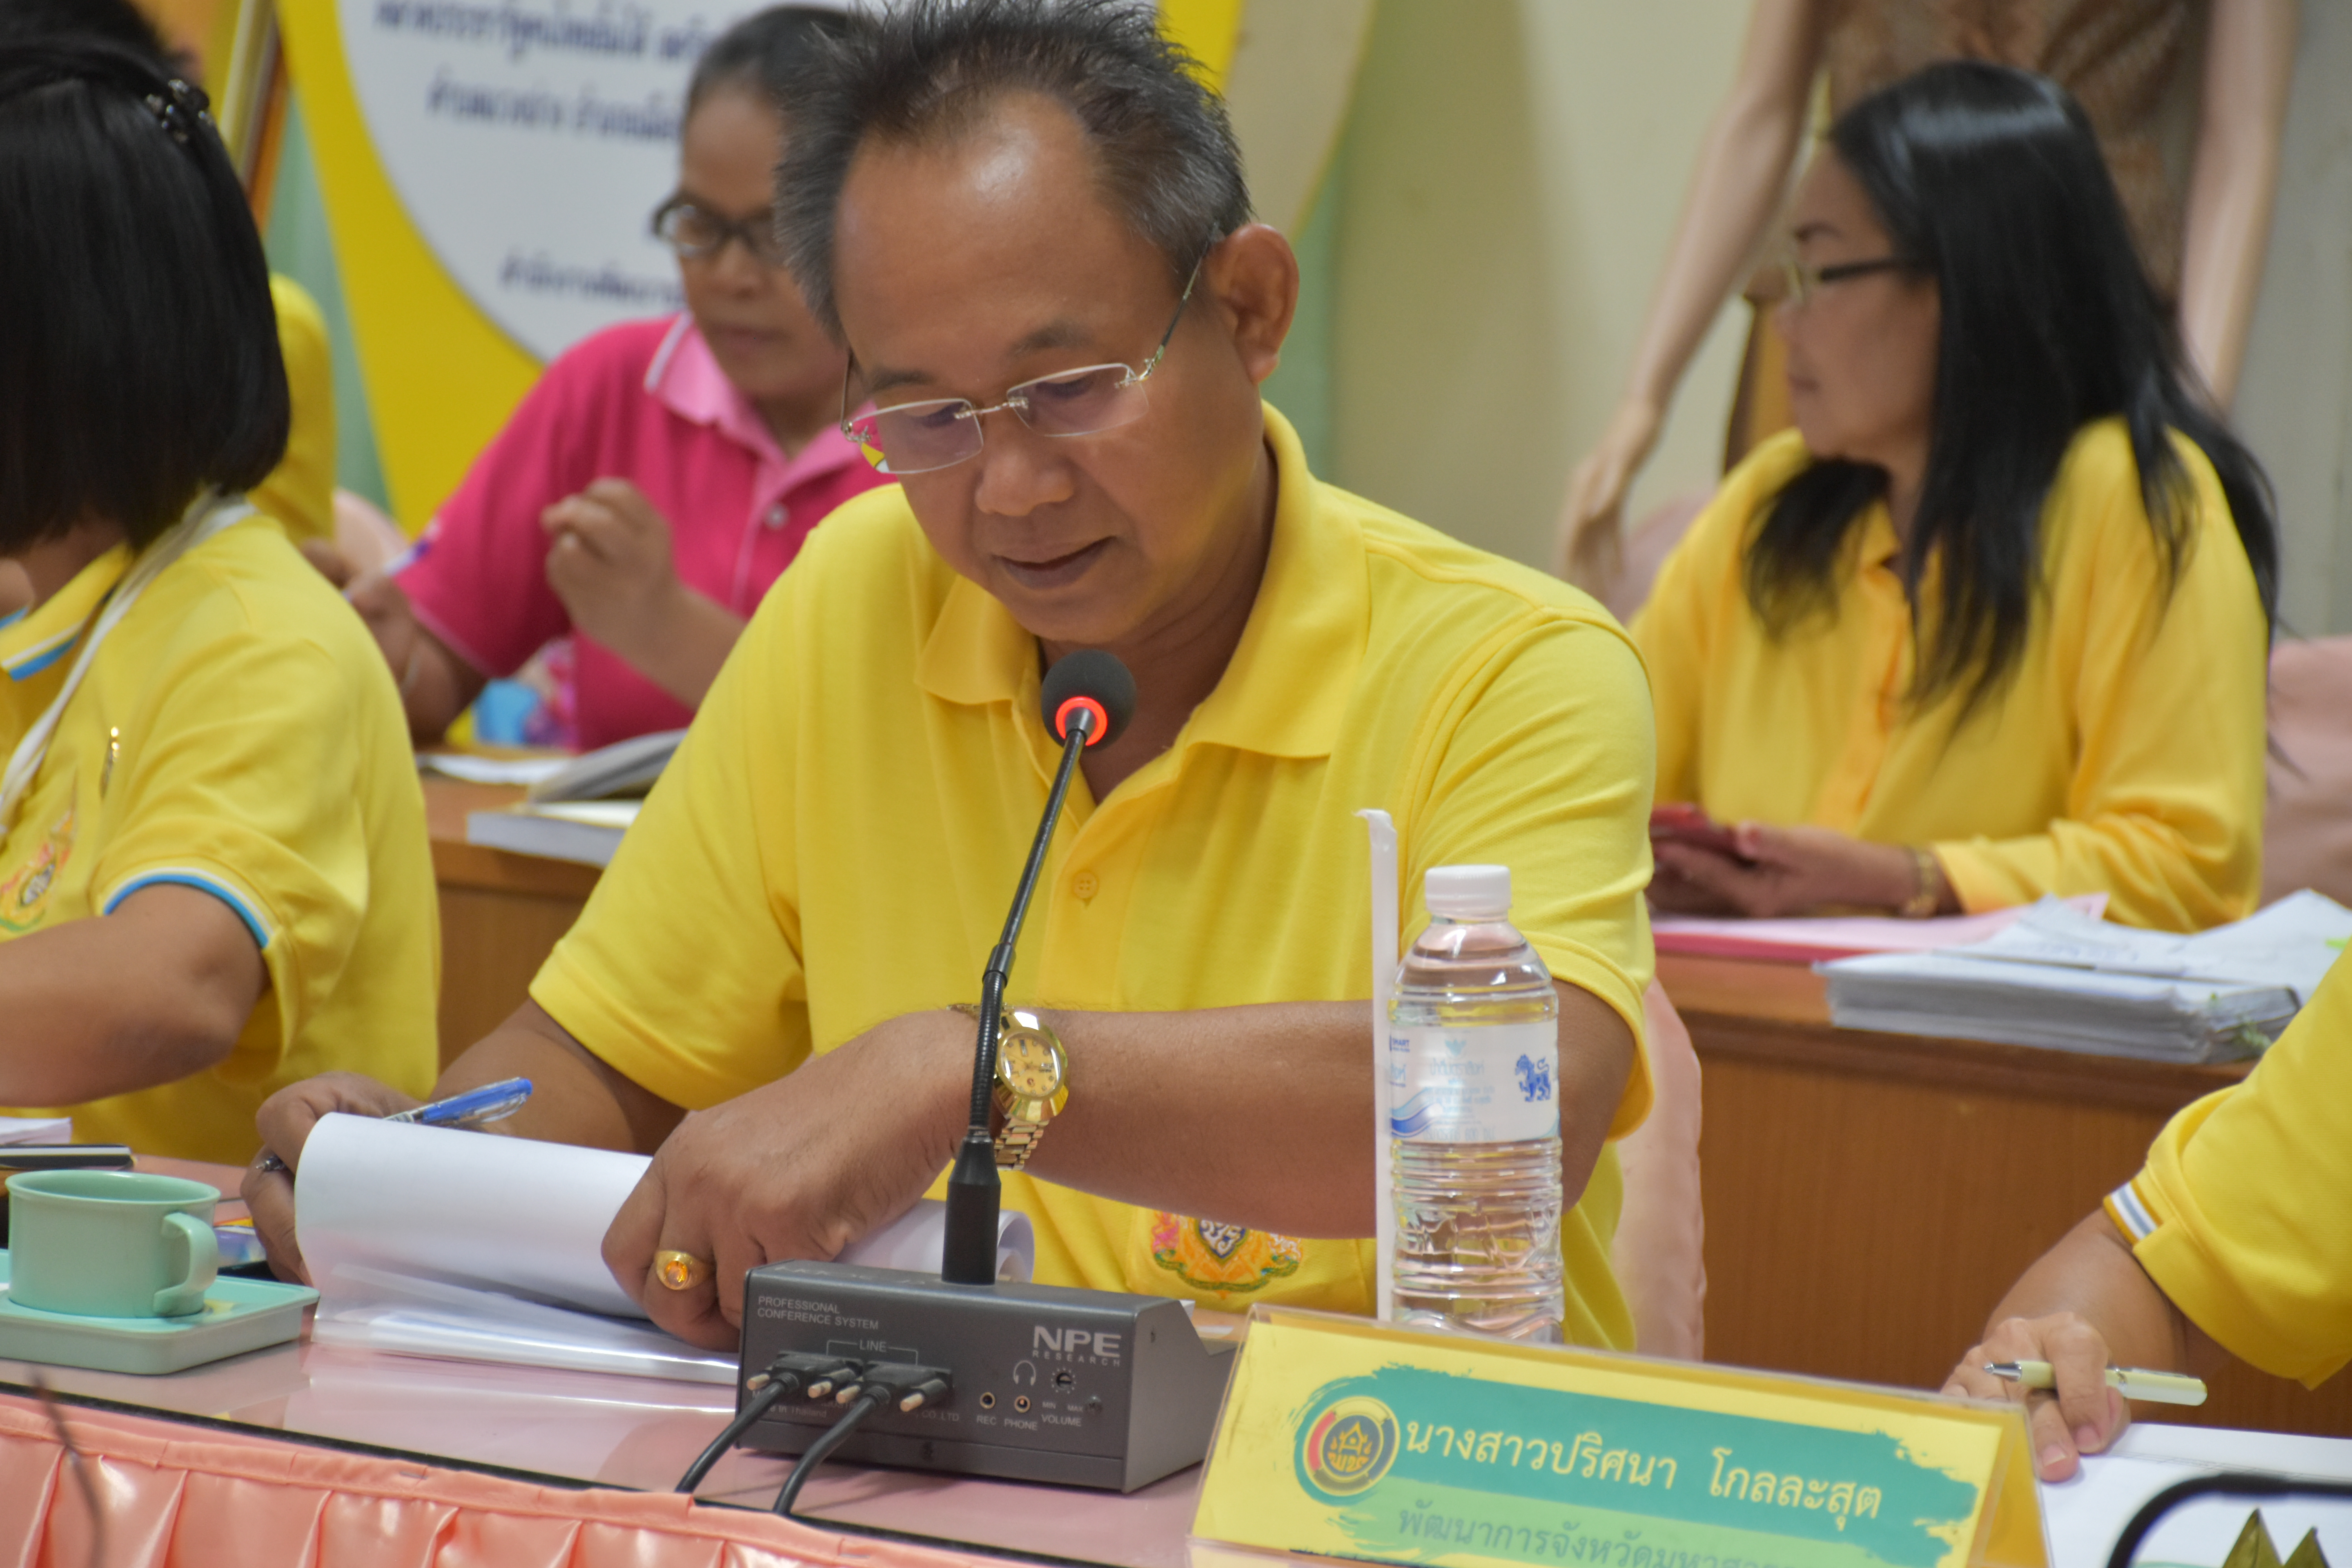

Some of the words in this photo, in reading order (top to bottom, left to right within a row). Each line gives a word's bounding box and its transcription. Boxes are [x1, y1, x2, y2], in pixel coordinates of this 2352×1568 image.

[758, 1296, 840, 1314] PROFESSIONAL
[757, 1308, 831, 1325] CONFERENCE
[834, 1316, 879, 1330] SYSTEM
[859, 1339, 887, 1353] LINE
[1033, 1325, 1122, 1358] NPE
[1032, 1349, 1121, 1367] RESEARCH
[1042, 1401, 1056, 1410] MIN
[1067, 1404, 1084, 1413] MAX
[976, 1414, 997, 1426] REC
[1004, 1418, 1038, 1431] PHONE
[1041, 1414, 1082, 1427] VOLUME
[1406, 1420, 1678, 1490] นางสาวปริศนา
[1710, 1446, 1883, 1532] โกลละสุต
